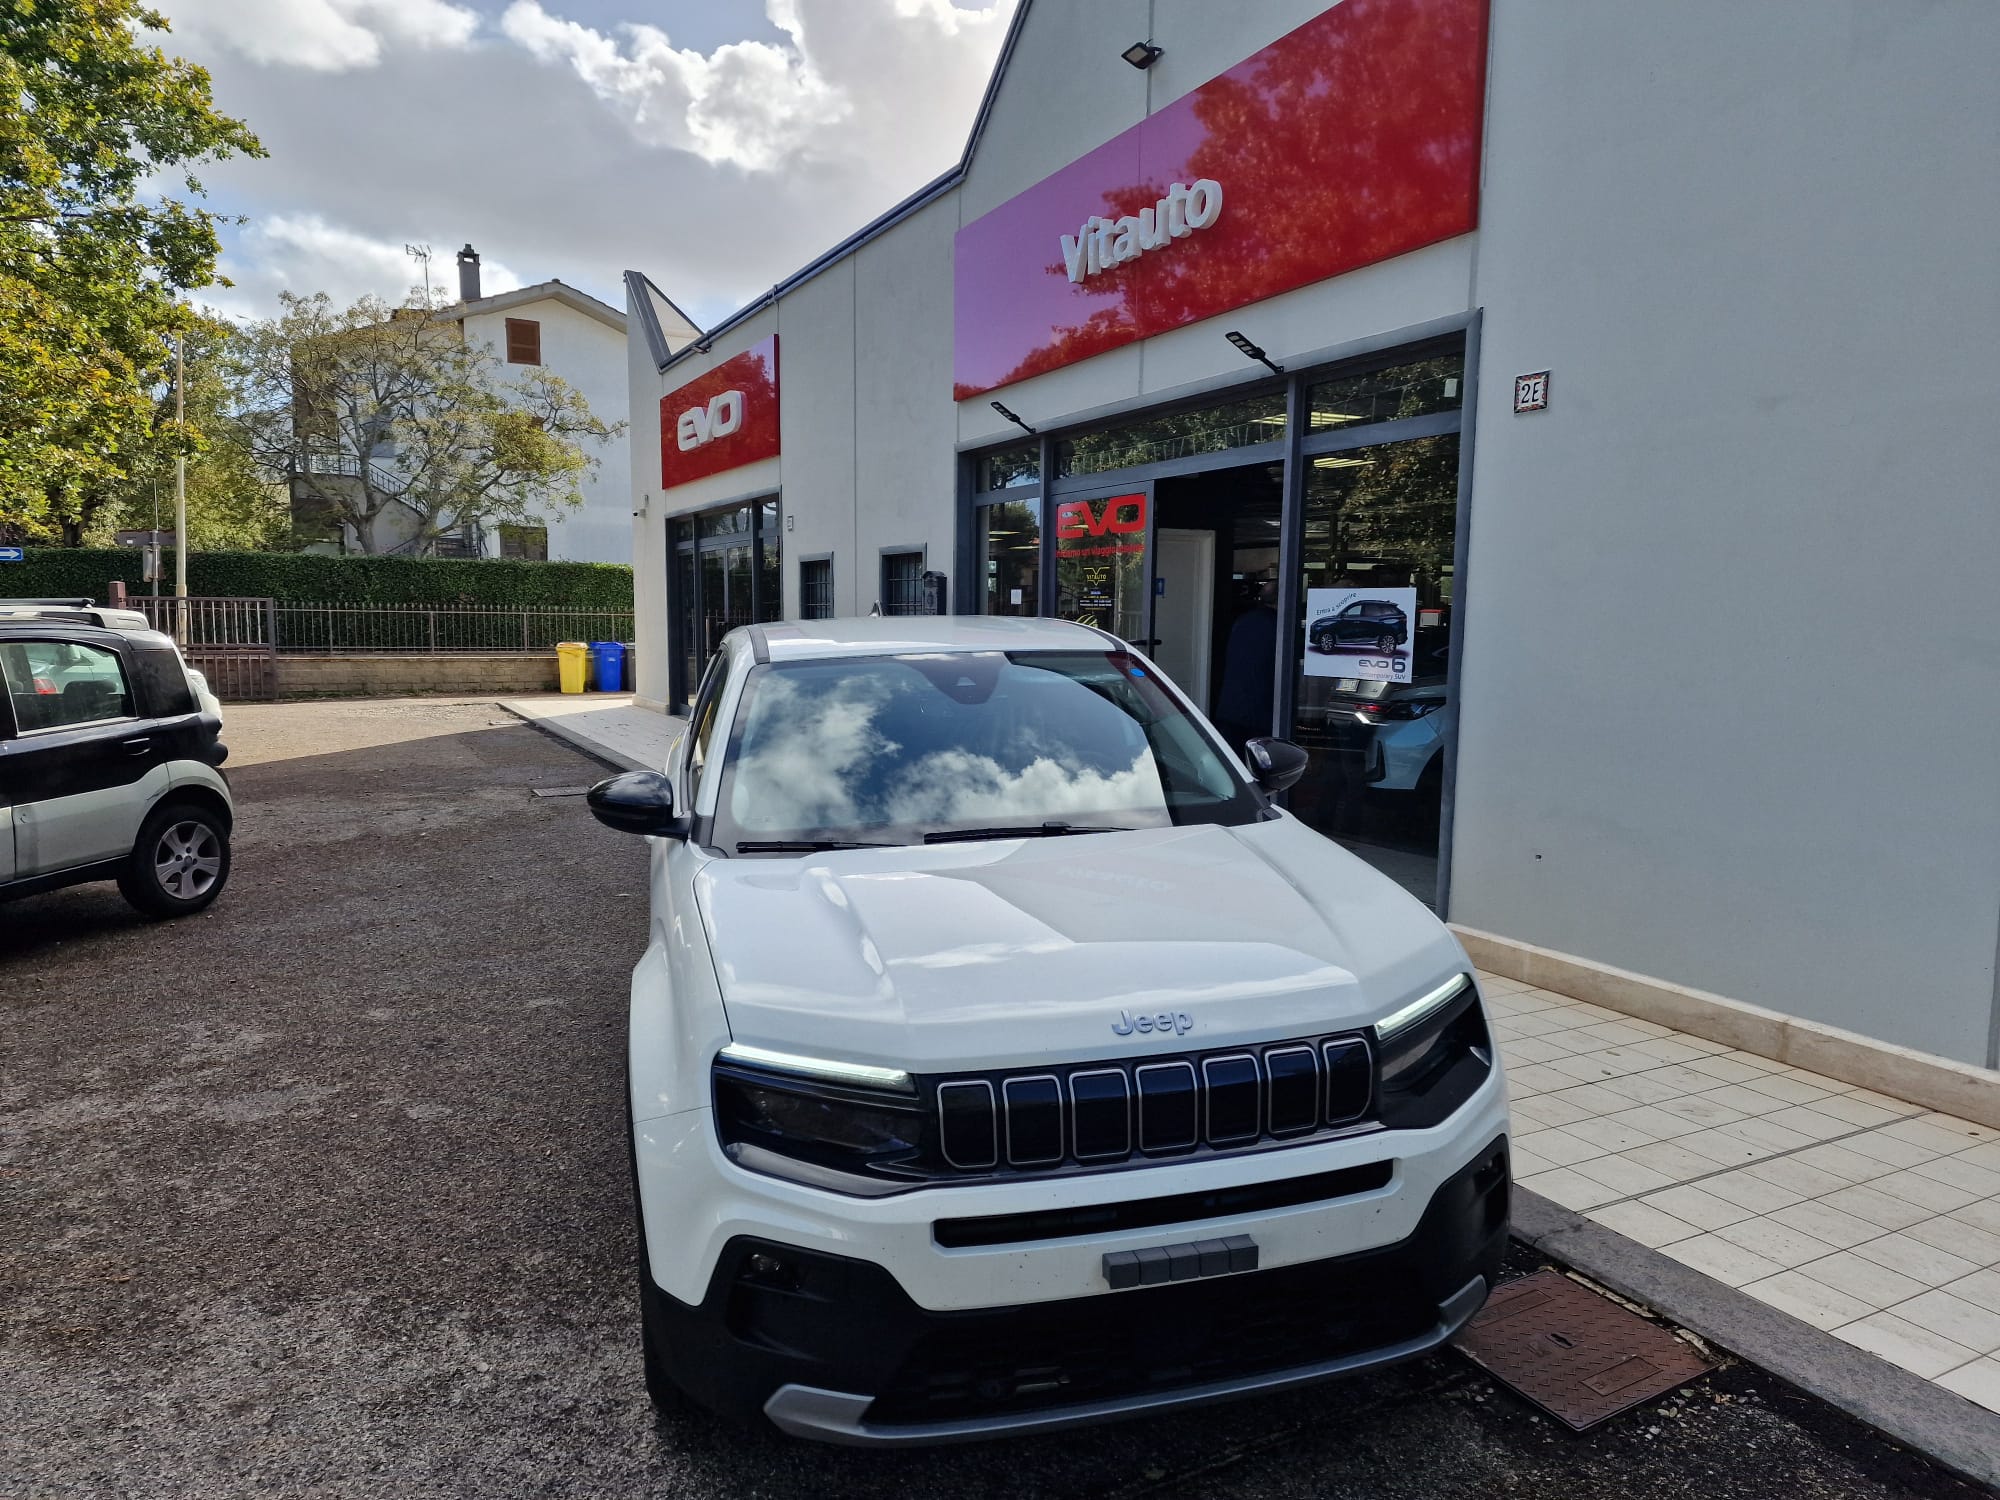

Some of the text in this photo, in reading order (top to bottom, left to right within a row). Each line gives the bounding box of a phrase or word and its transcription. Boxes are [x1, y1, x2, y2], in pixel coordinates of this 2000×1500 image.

[1060, 178, 1223, 283] Vitauto
[1521, 381, 1541, 404] 2E
[677, 389, 743, 452] EVO
[1056, 493, 1147, 538] EVO
[1316, 608, 1331, 616] Entra
[1359, 655, 1406, 674] EVO 6
[1111, 1008, 1193, 1036] Jeep
